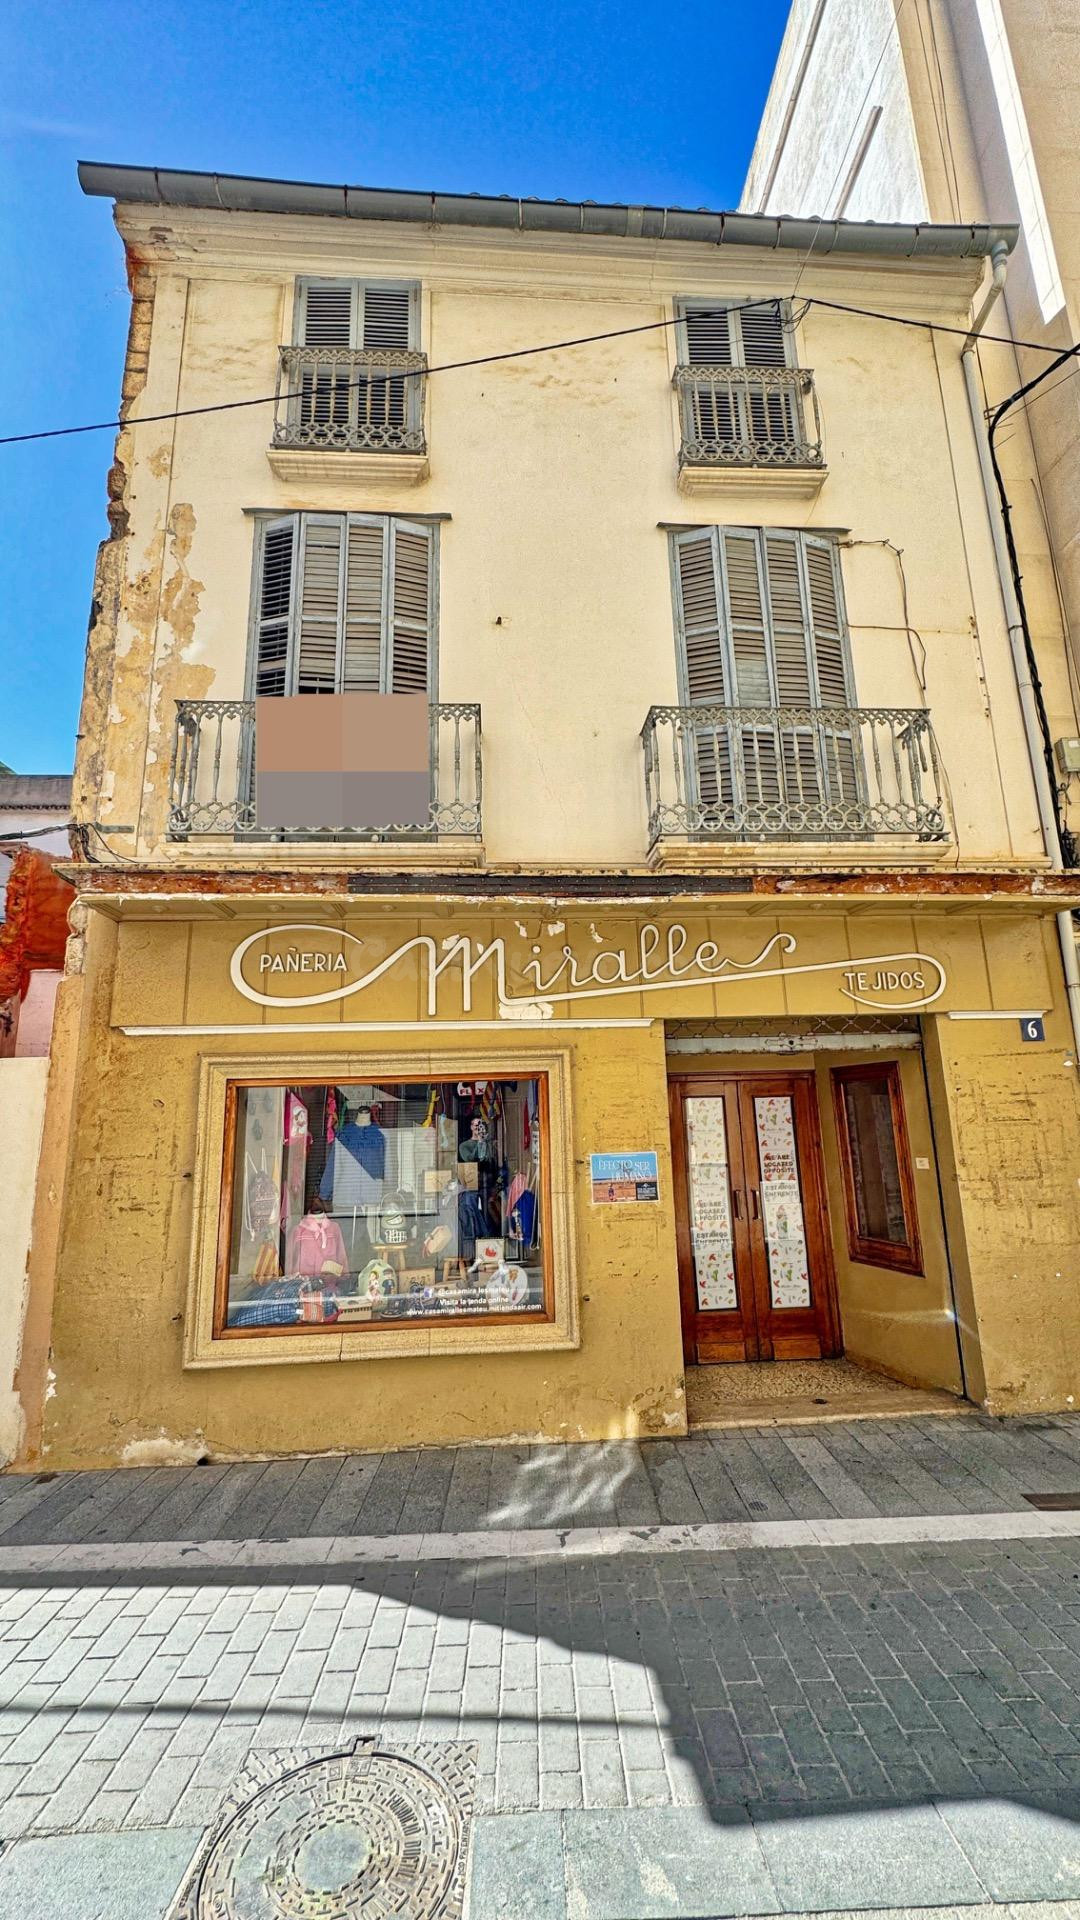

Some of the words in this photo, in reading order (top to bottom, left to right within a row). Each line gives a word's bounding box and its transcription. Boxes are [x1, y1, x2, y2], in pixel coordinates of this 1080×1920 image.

[259, 946, 348, 974] PAÑERIA
[843, 971, 926, 992] TEJIDOS
[1027, 1020, 1038, 1038] 6
